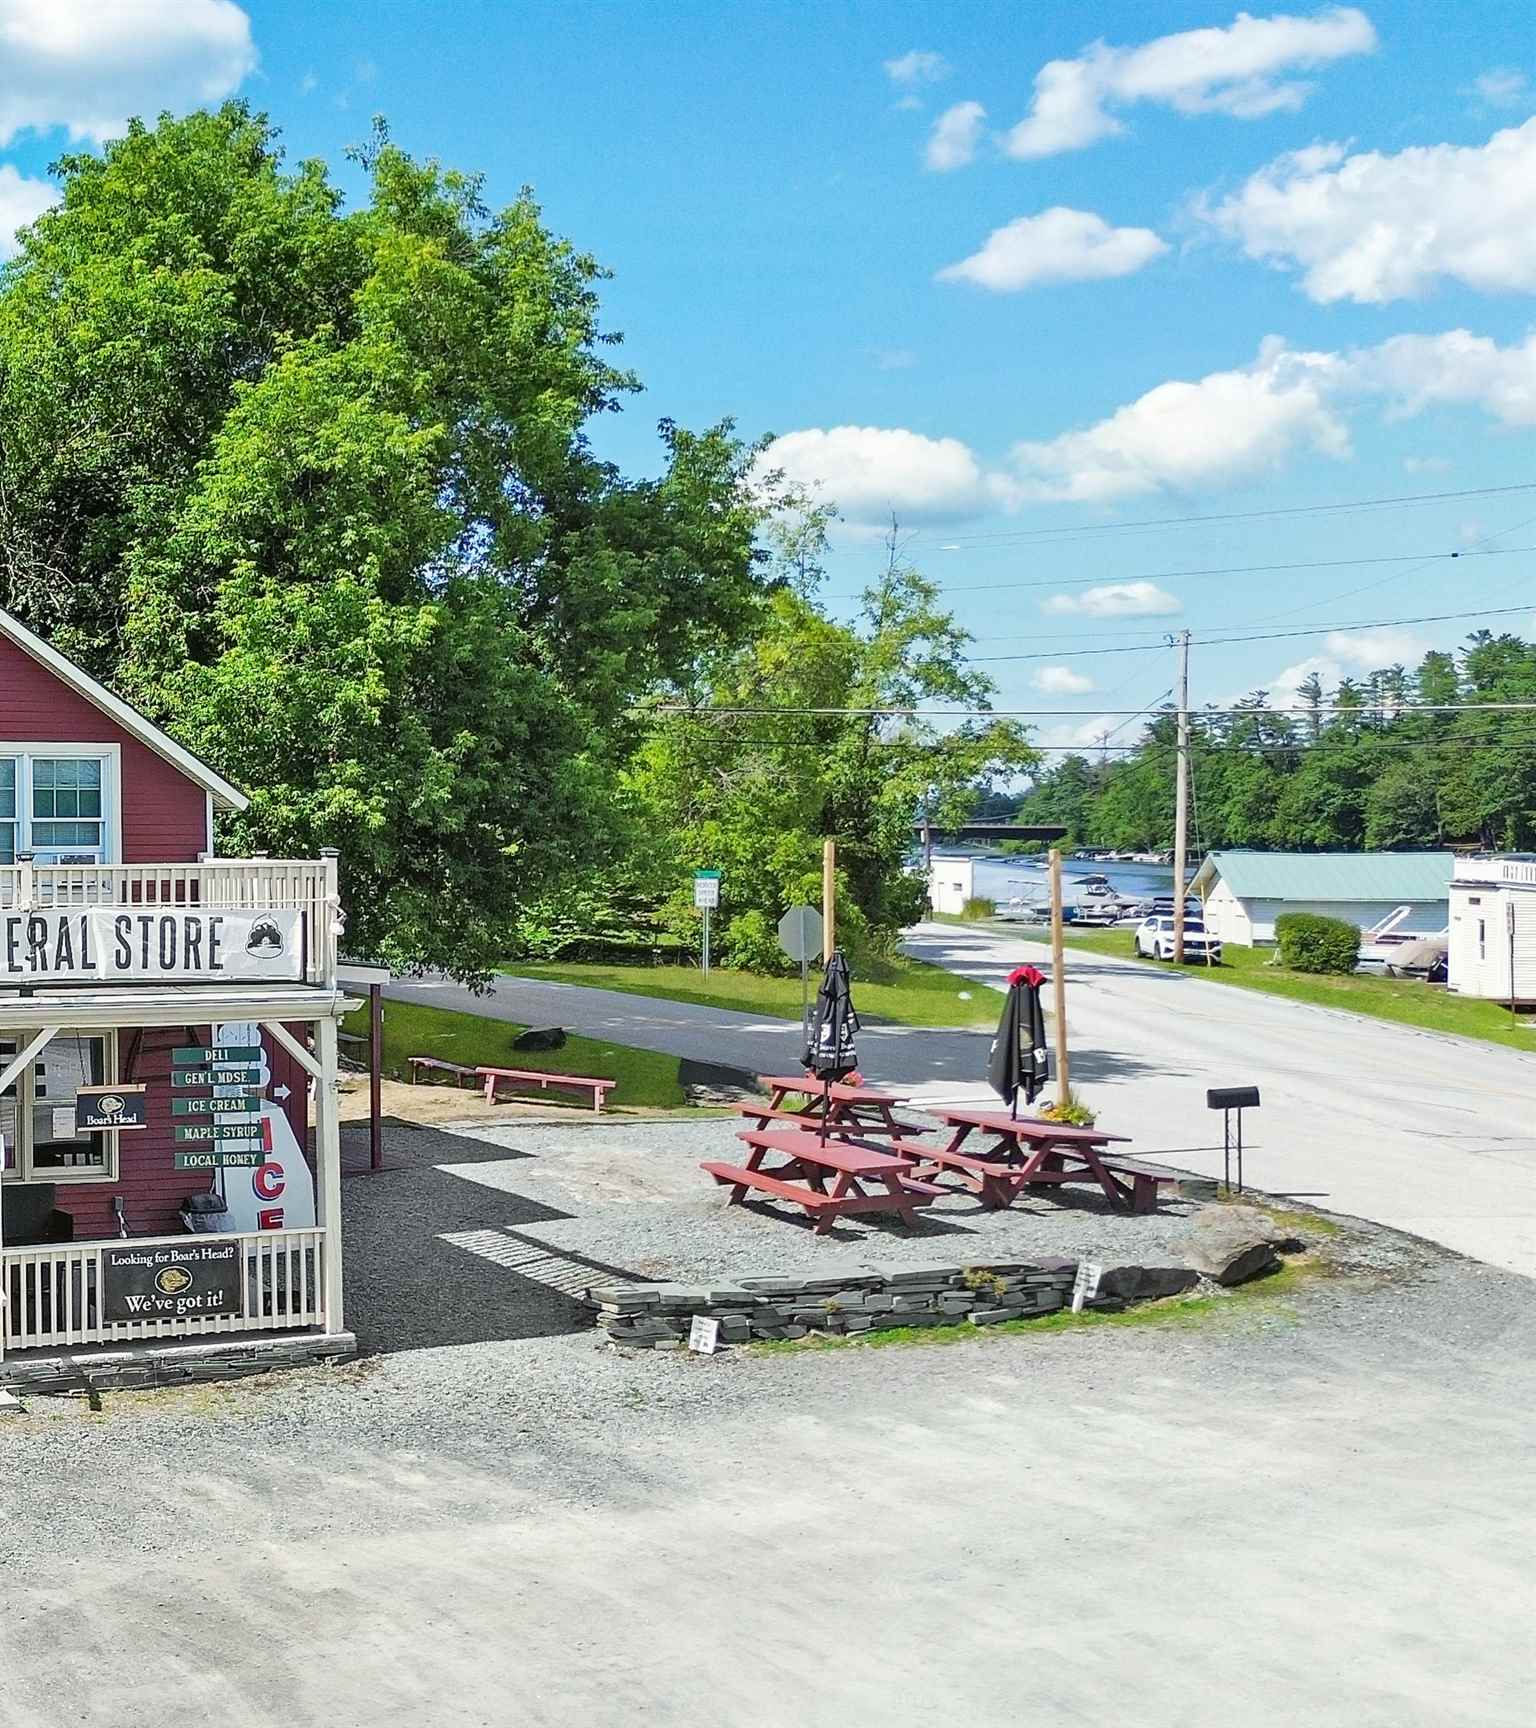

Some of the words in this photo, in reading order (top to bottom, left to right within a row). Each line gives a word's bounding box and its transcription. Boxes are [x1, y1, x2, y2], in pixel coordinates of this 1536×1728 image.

[115, 915, 224, 972] STORE
[205, 1049, 228, 1061] DELI
[185, 1071, 214, 1084] GEN'L
[188, 1099, 206, 1112] ICE
[210, 1098, 246, 1111] CREAM
[87, 1114, 112, 1125] Boar's
[113, 1113, 137, 1124] Head
[184, 1127, 218, 1140] MAPLE
[223, 1126, 258, 1138] SYRUP
[184, 1155, 218, 1166] LOCAL
[222, 1153, 257, 1165] HONEY
[111, 1254, 154, 1267] Looking
[155, 1251, 169, 1263] for
[171, 1249, 200, 1262] Boar's
[201, 1247, 234, 1260] Head?
[124, 1293, 173, 1313] We've
[177, 1294, 203, 1314] got
[207, 1290, 224, 1306] it!
